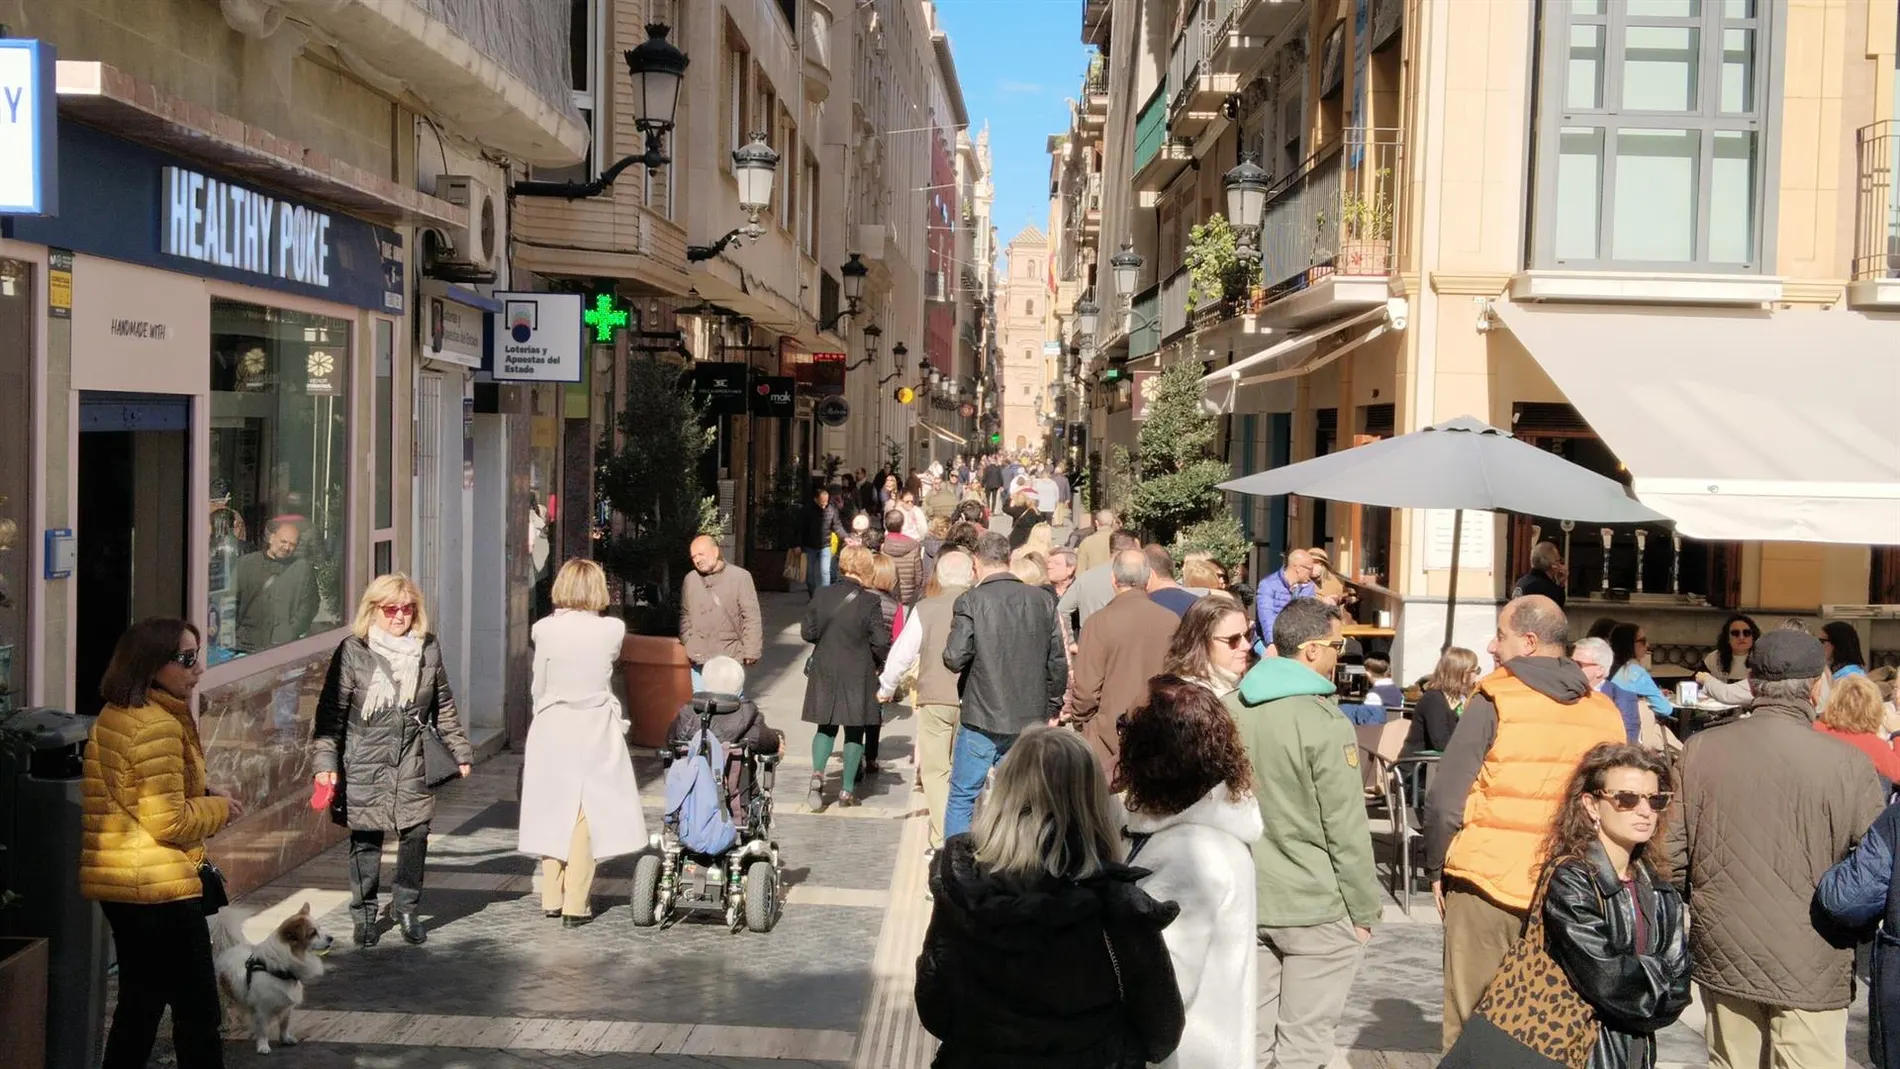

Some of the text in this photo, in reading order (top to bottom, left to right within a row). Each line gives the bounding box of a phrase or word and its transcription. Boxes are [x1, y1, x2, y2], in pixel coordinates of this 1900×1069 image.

[170, 165, 331, 287] HEALTHY POKE
[110, 318, 167, 341] HANDMADE WITH
[542, 347, 548, 356] y
[505, 355, 561, 365] Apuestas del
[504, 364, 535, 373] Estado
[770, 391, 791, 401] mak
